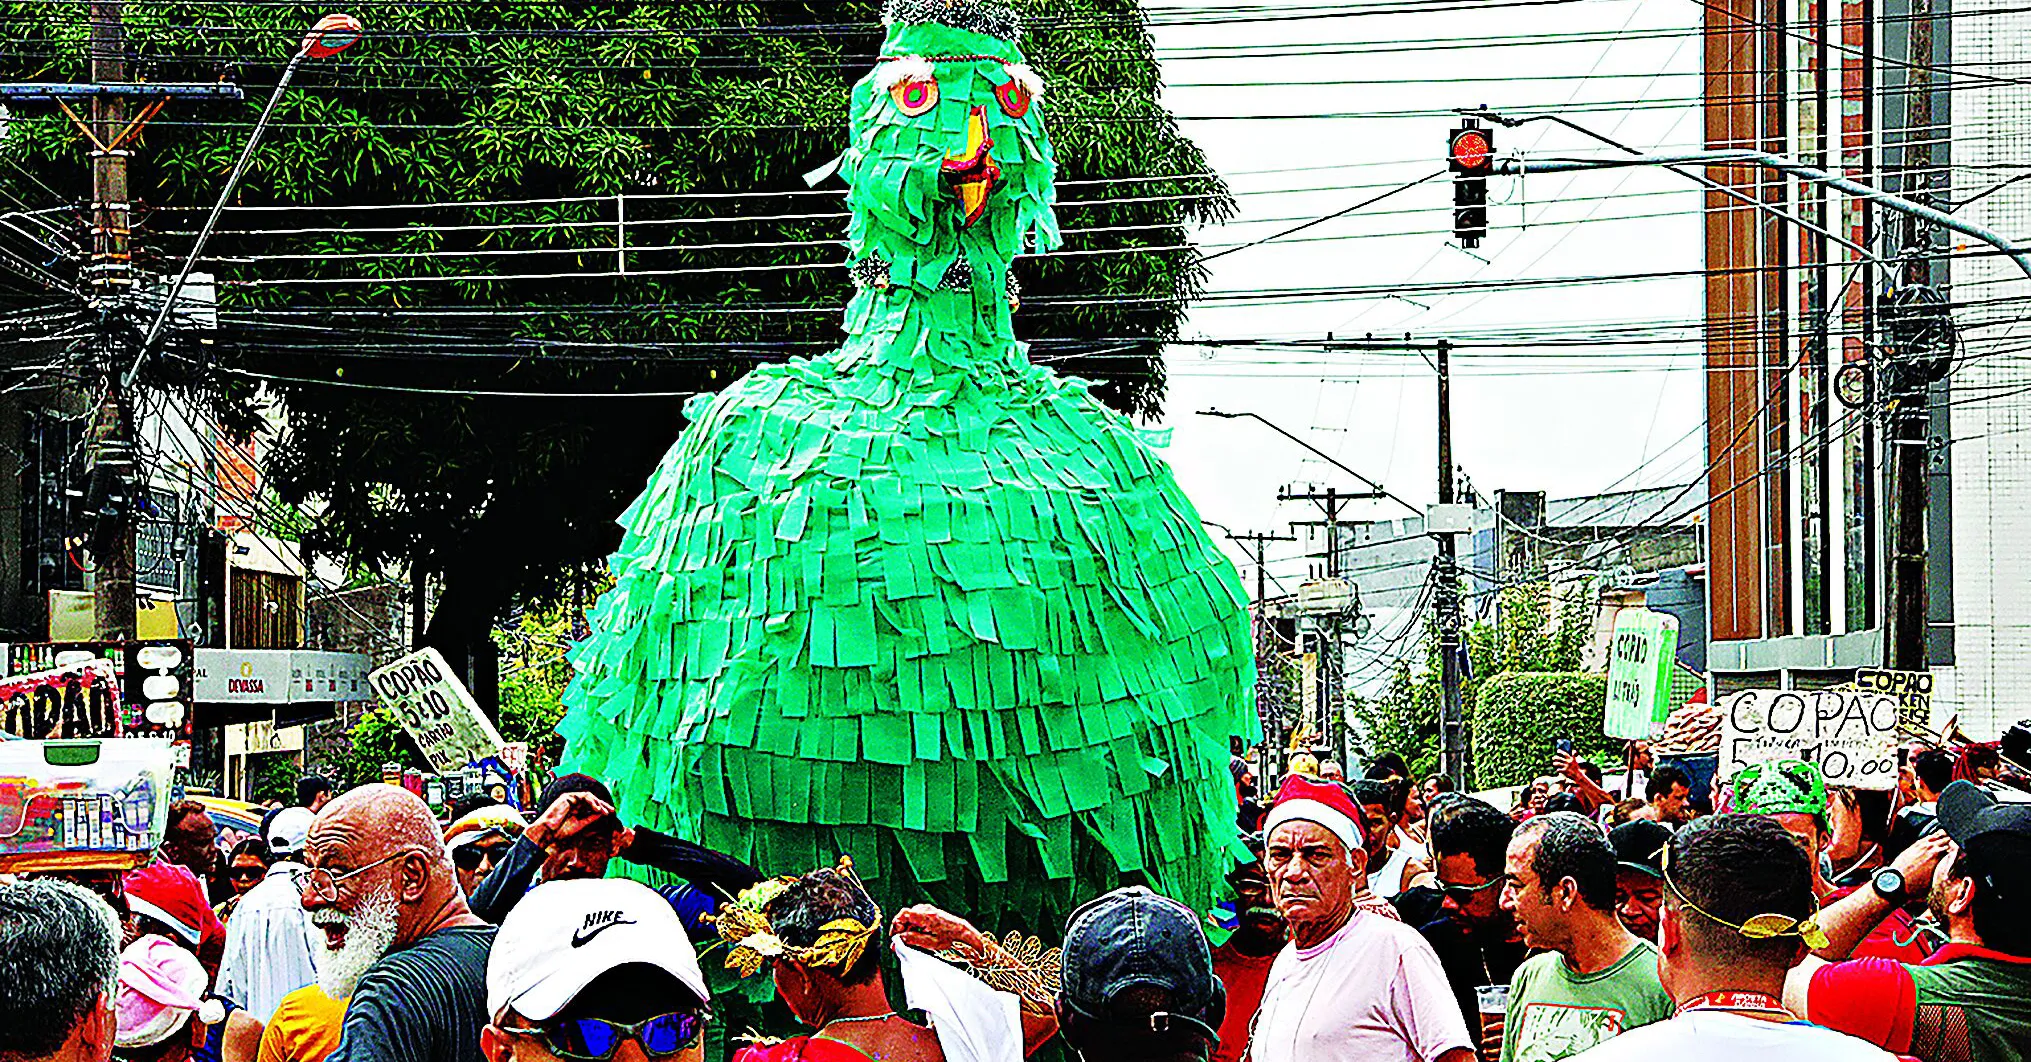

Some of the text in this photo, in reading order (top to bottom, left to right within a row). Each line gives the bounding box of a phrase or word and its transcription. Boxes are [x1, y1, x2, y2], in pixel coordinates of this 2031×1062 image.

[228, 679, 264, 694] DEVASSA
[378, 658, 443, 701] COPÃO
[399, 700, 421, 728] 5
[422, 690, 450, 720] 10
[429, 749, 452, 770] PIX
[583, 910, 624, 930] NIKE
